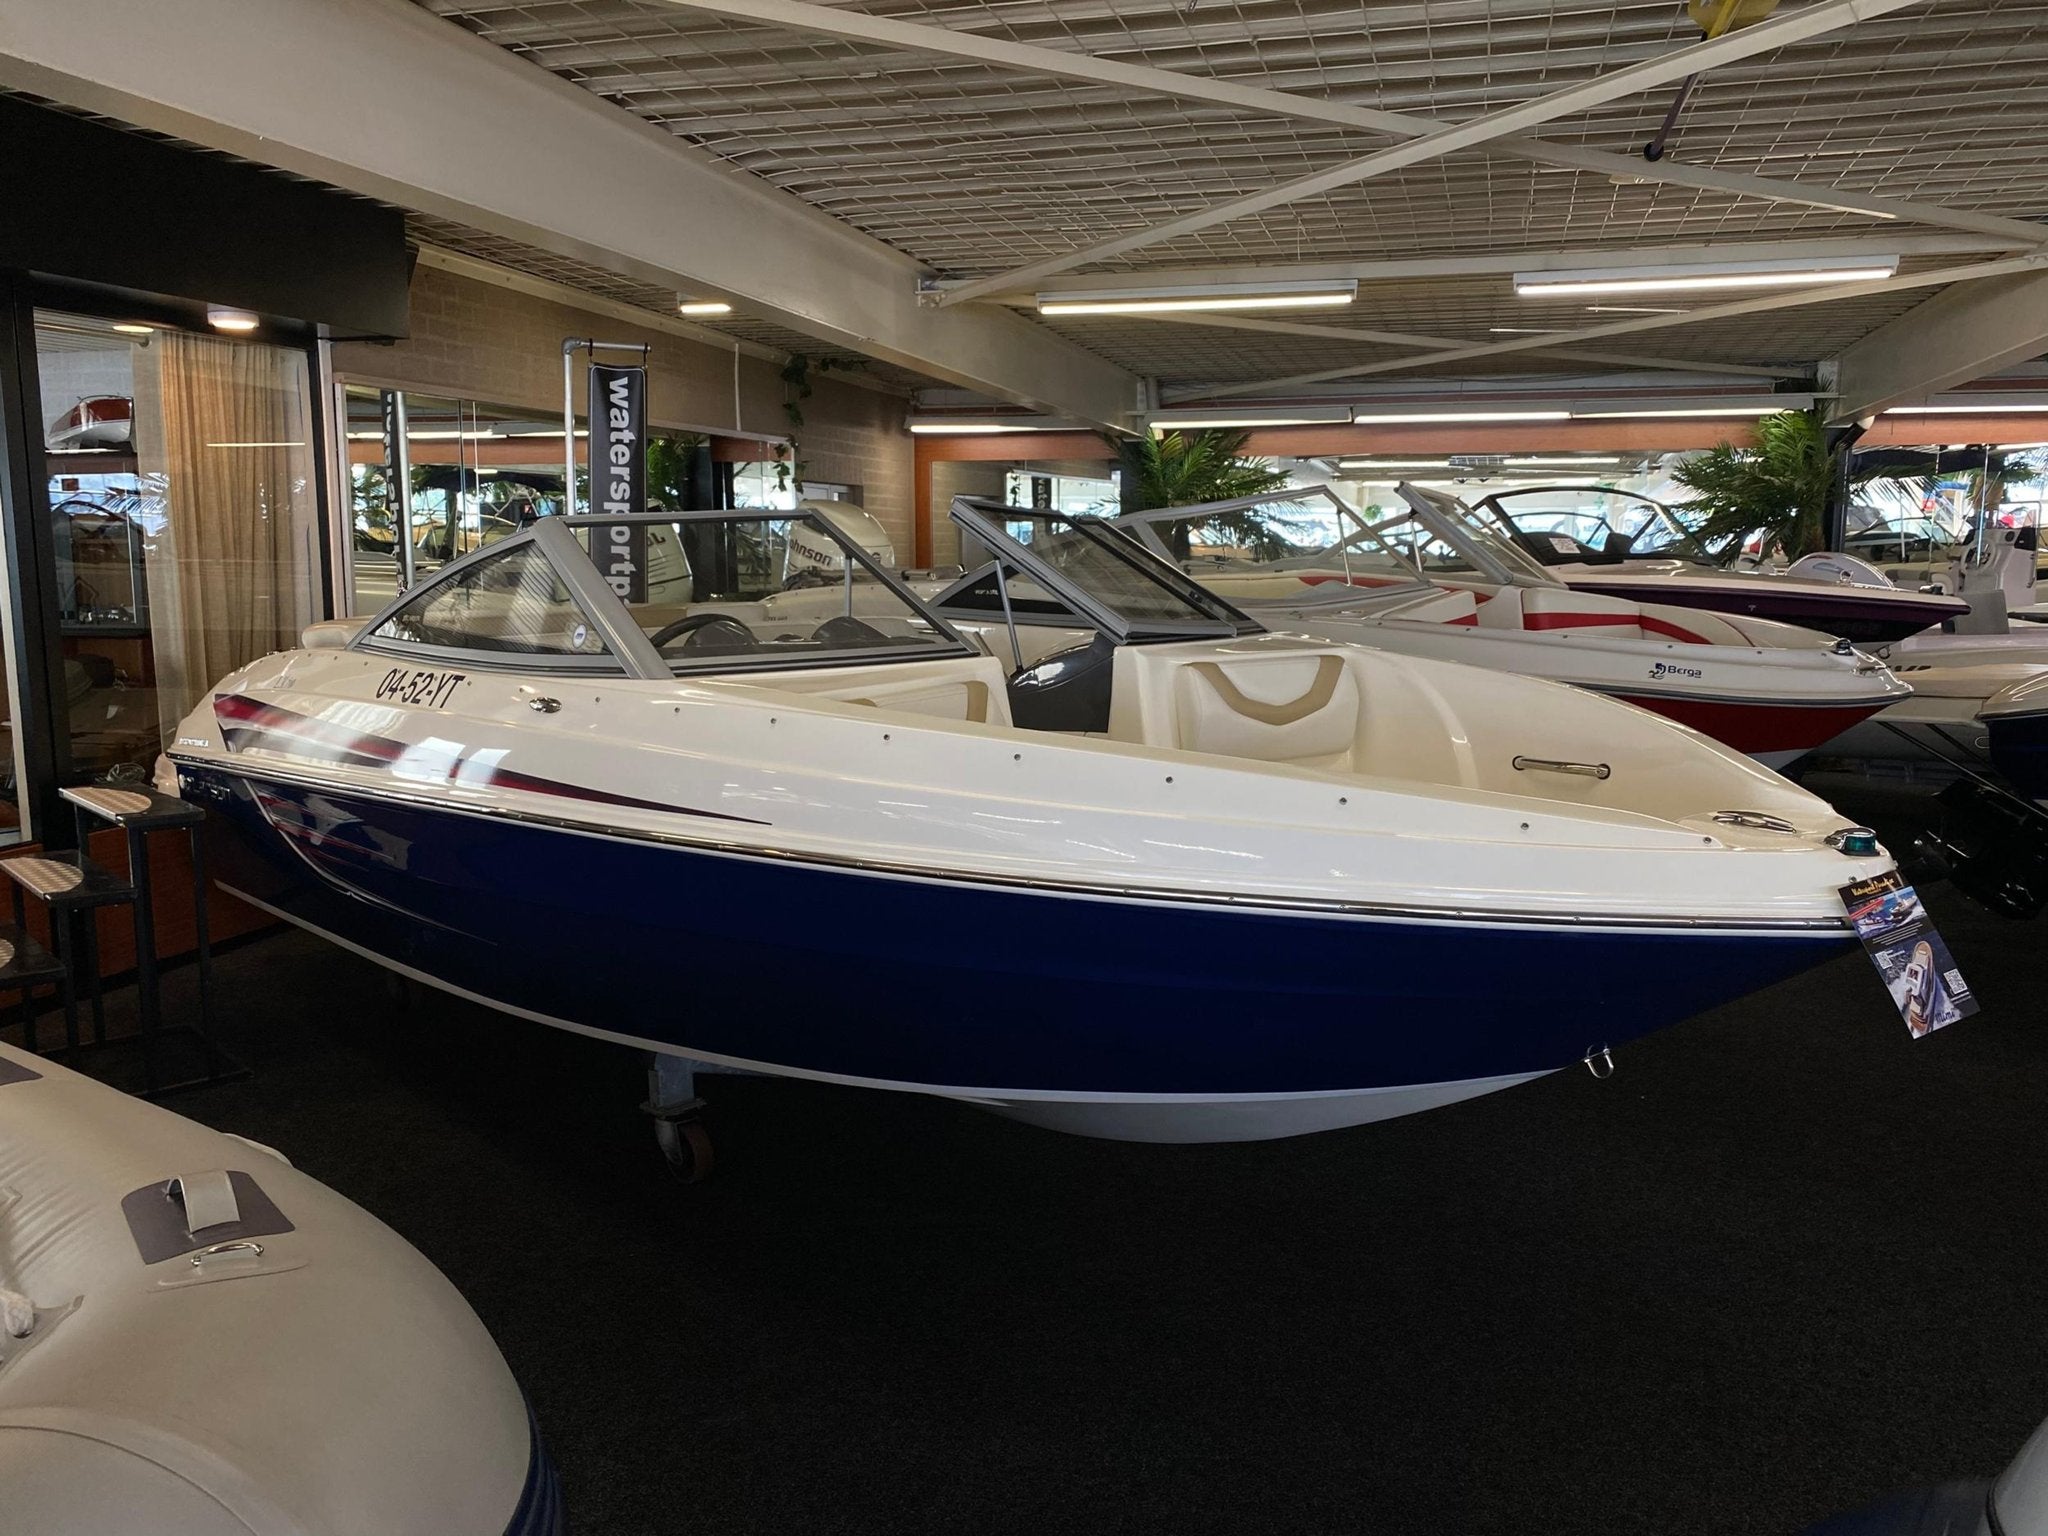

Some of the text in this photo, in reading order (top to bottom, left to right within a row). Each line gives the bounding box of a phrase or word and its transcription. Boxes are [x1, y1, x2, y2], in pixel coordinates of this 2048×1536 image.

[789, 538, 833, 567] ohnson
[1667, 665, 1702, 678] Berga
[376, 668, 466, 709] 04-52-YT
